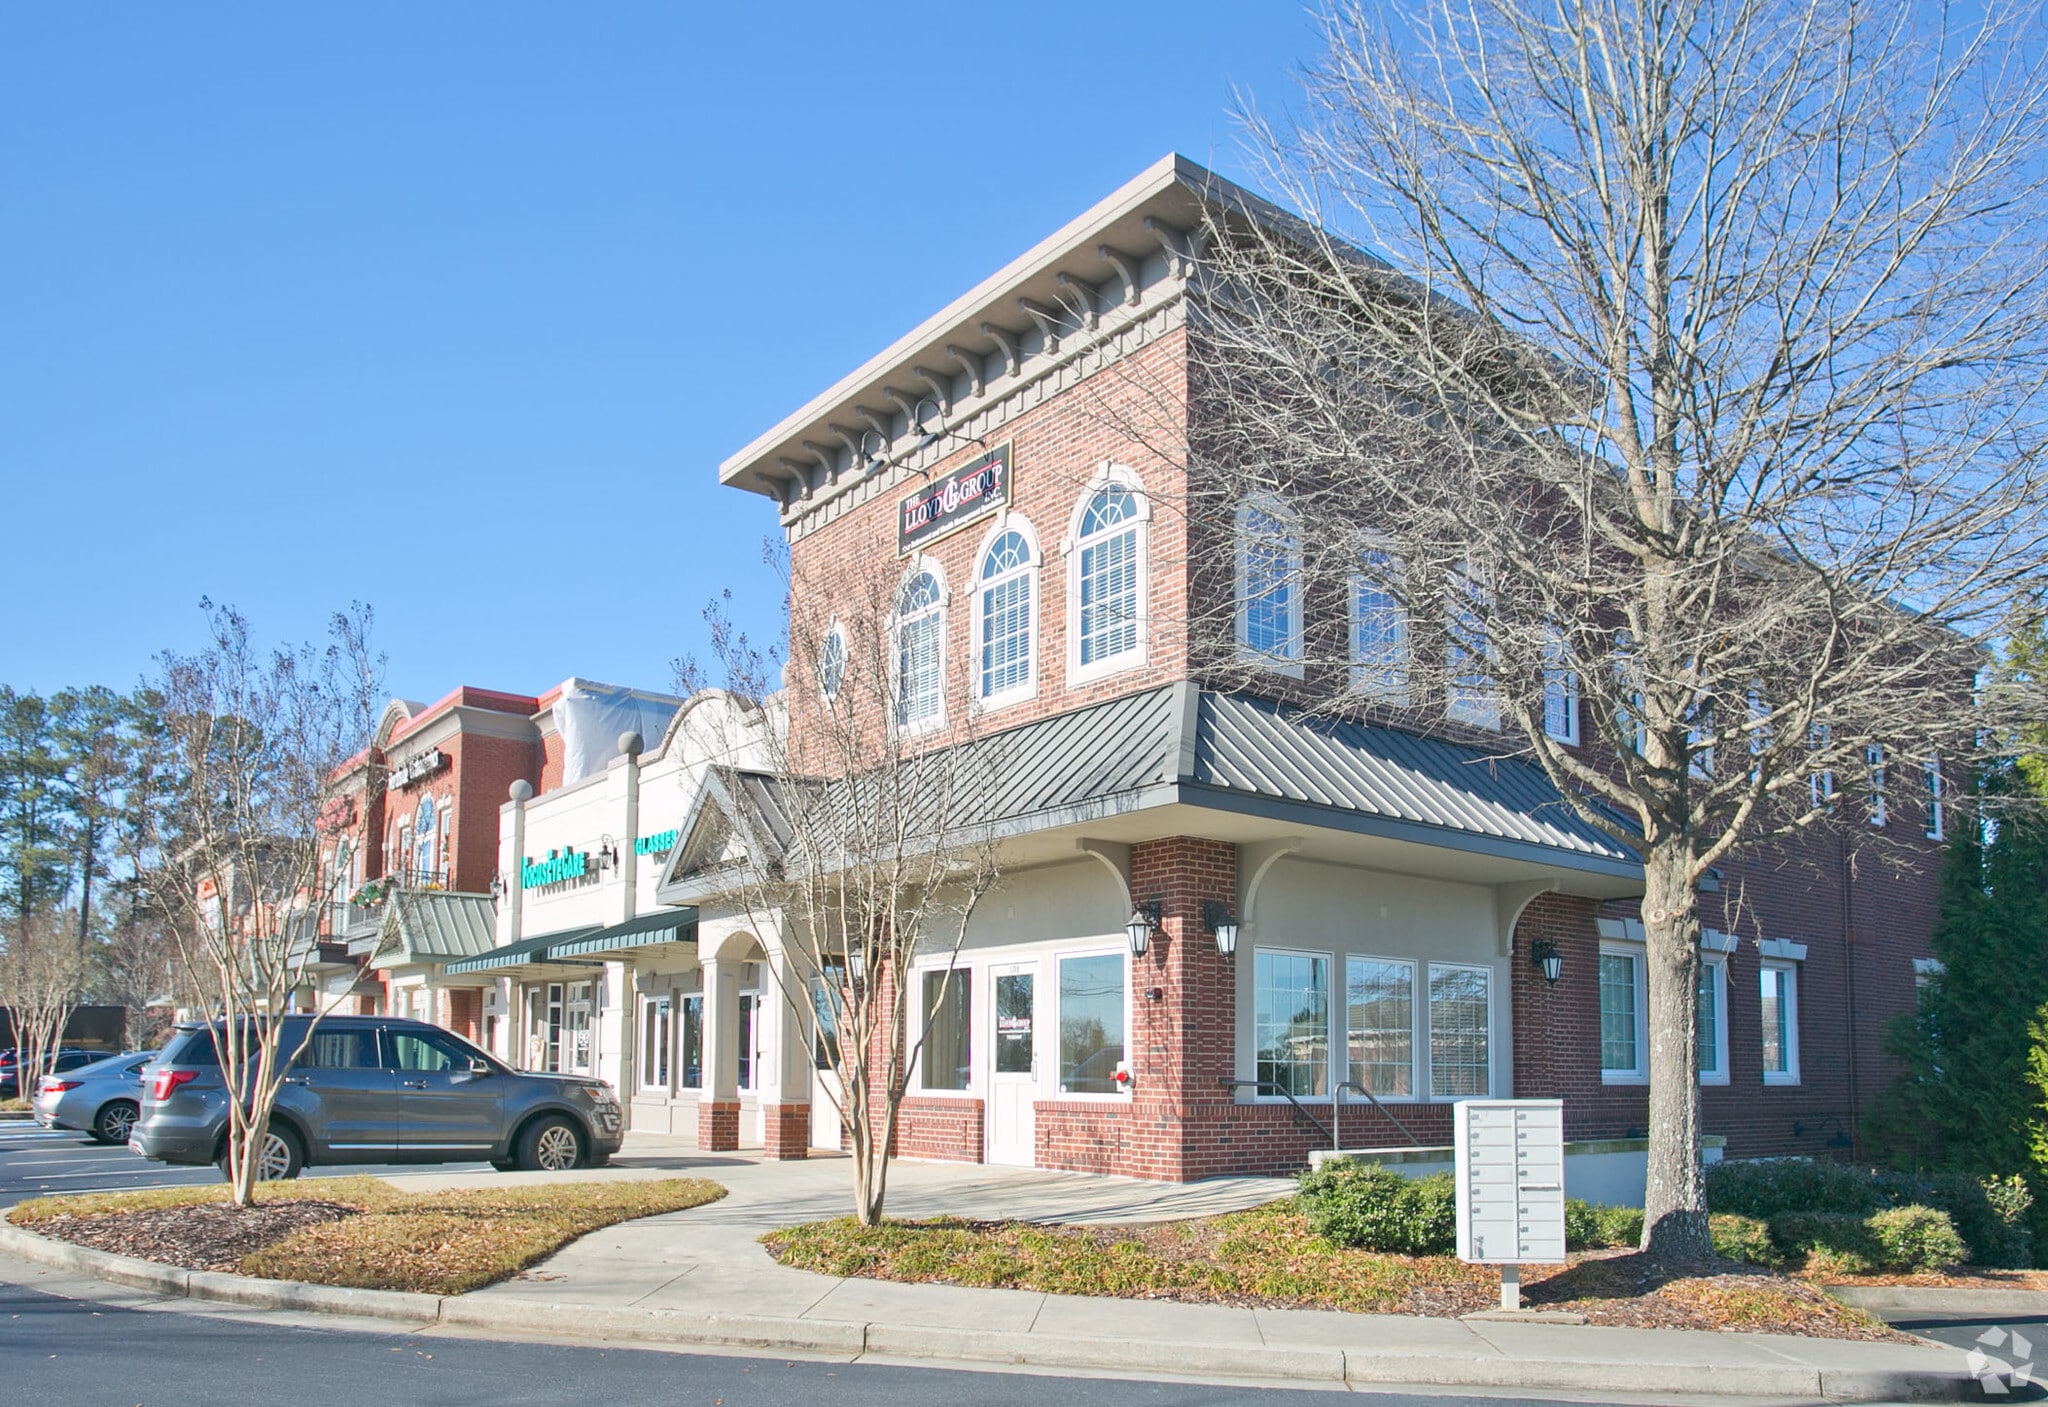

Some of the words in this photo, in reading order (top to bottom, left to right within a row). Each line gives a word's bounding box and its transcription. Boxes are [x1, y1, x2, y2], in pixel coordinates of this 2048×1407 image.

[905, 496, 942, 531] LLOYD
[960, 464, 1003, 500] GROUP
[905, 493, 920, 509] THE
[634, 829, 678, 857] GLASSES
